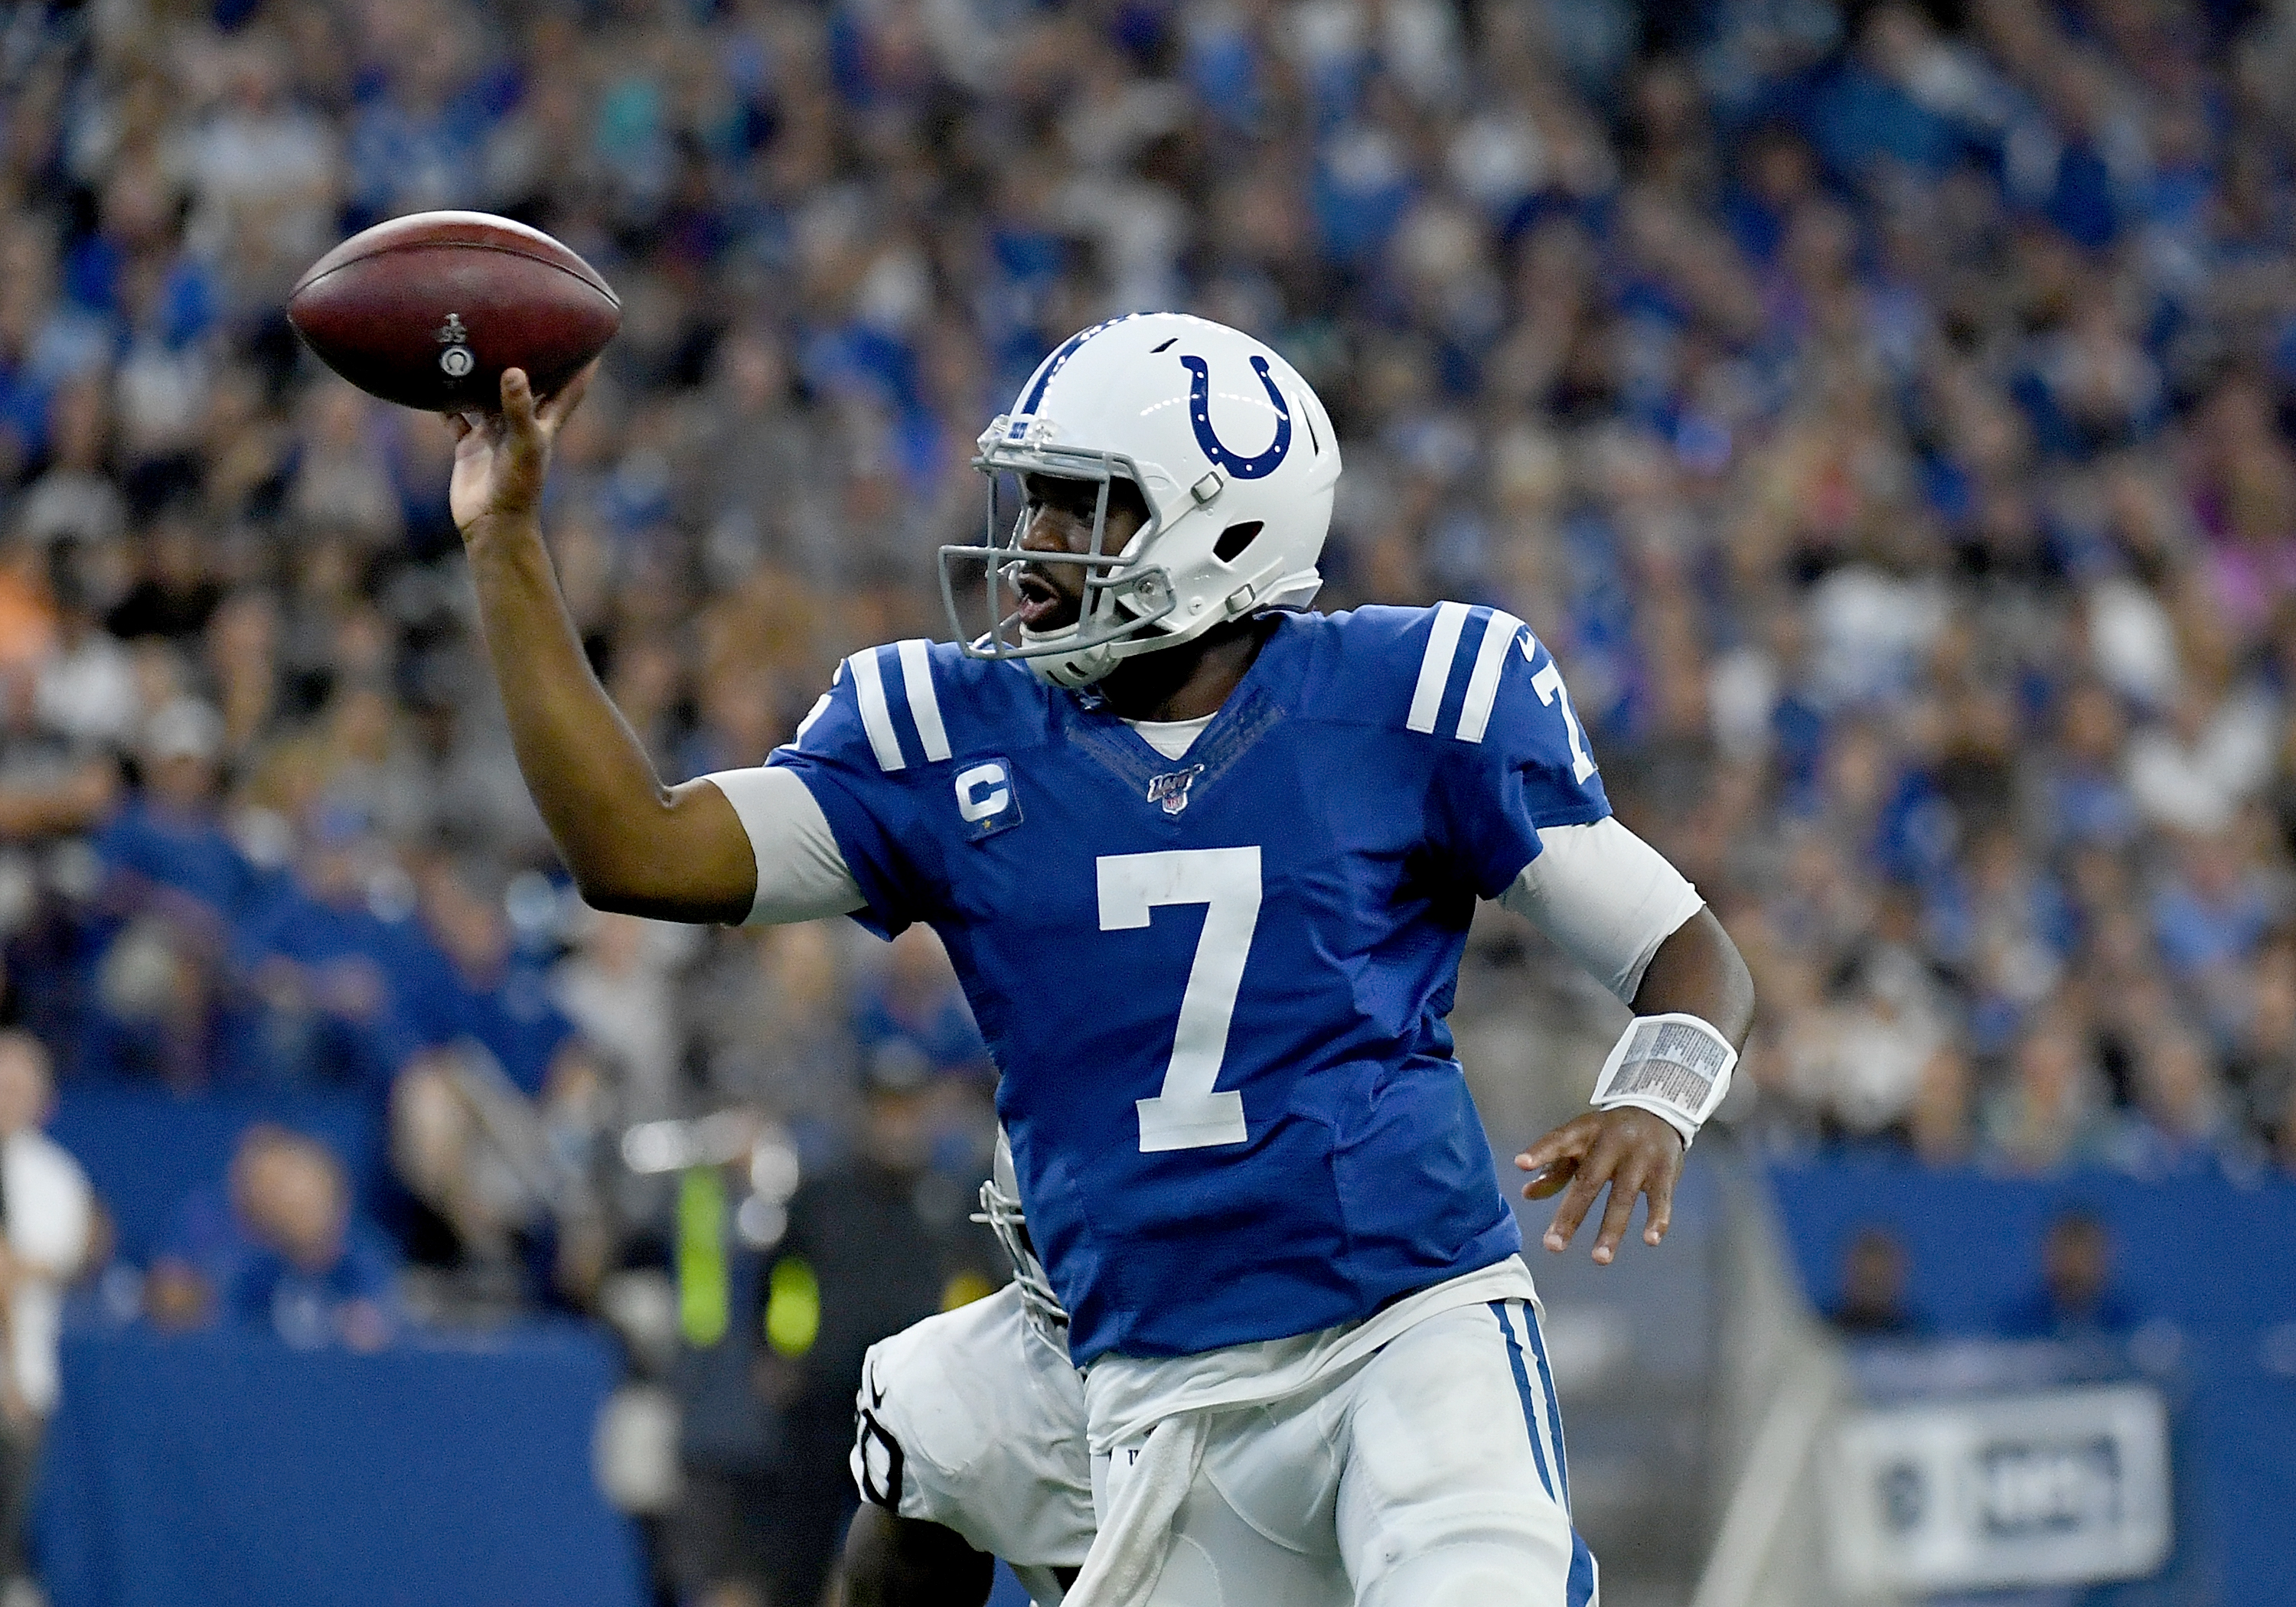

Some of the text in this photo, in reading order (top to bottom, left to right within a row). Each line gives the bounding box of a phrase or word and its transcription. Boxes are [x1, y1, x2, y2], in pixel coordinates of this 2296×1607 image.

[1531, 660, 1599, 786] 7
[955, 763, 1009, 823] C
[1096, 845, 1263, 1153] 7
